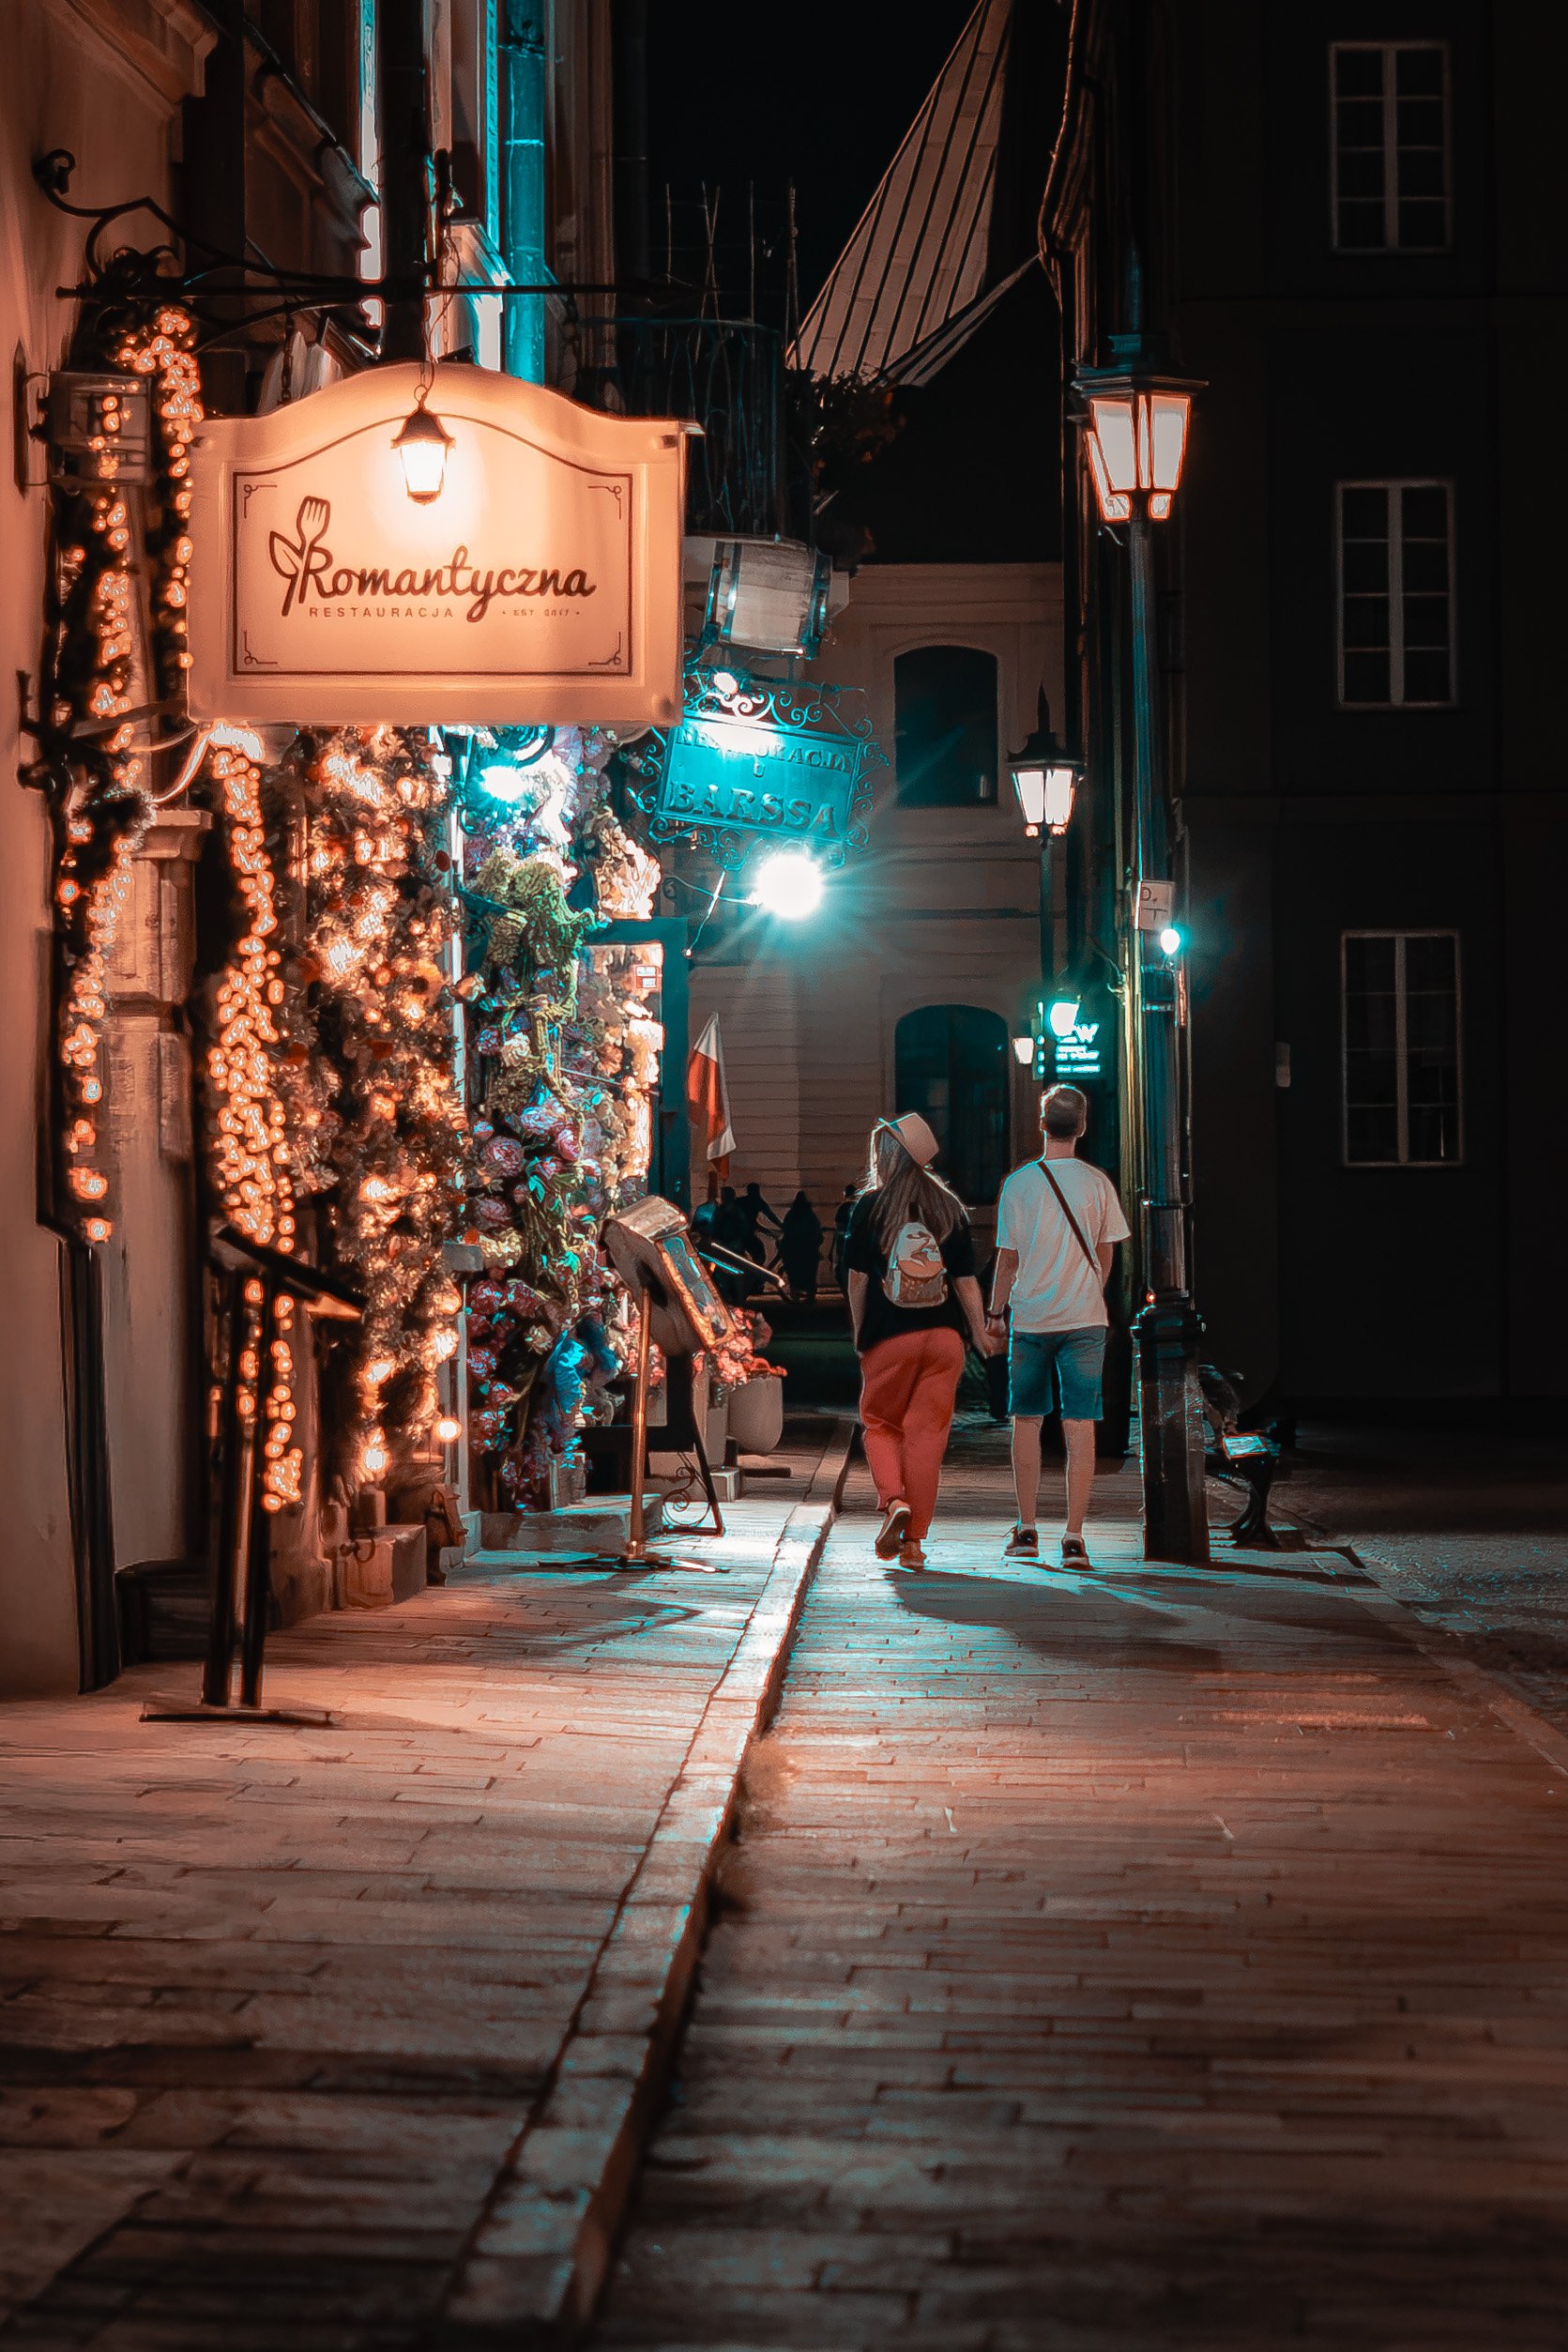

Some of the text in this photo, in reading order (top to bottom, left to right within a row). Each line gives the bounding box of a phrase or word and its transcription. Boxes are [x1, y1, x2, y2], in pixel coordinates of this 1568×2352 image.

[298, 545, 597, 622] Romantyczna
[309, 606, 453, 619] RESTAURACJA
[669, 780, 841, 837] BARSSA
